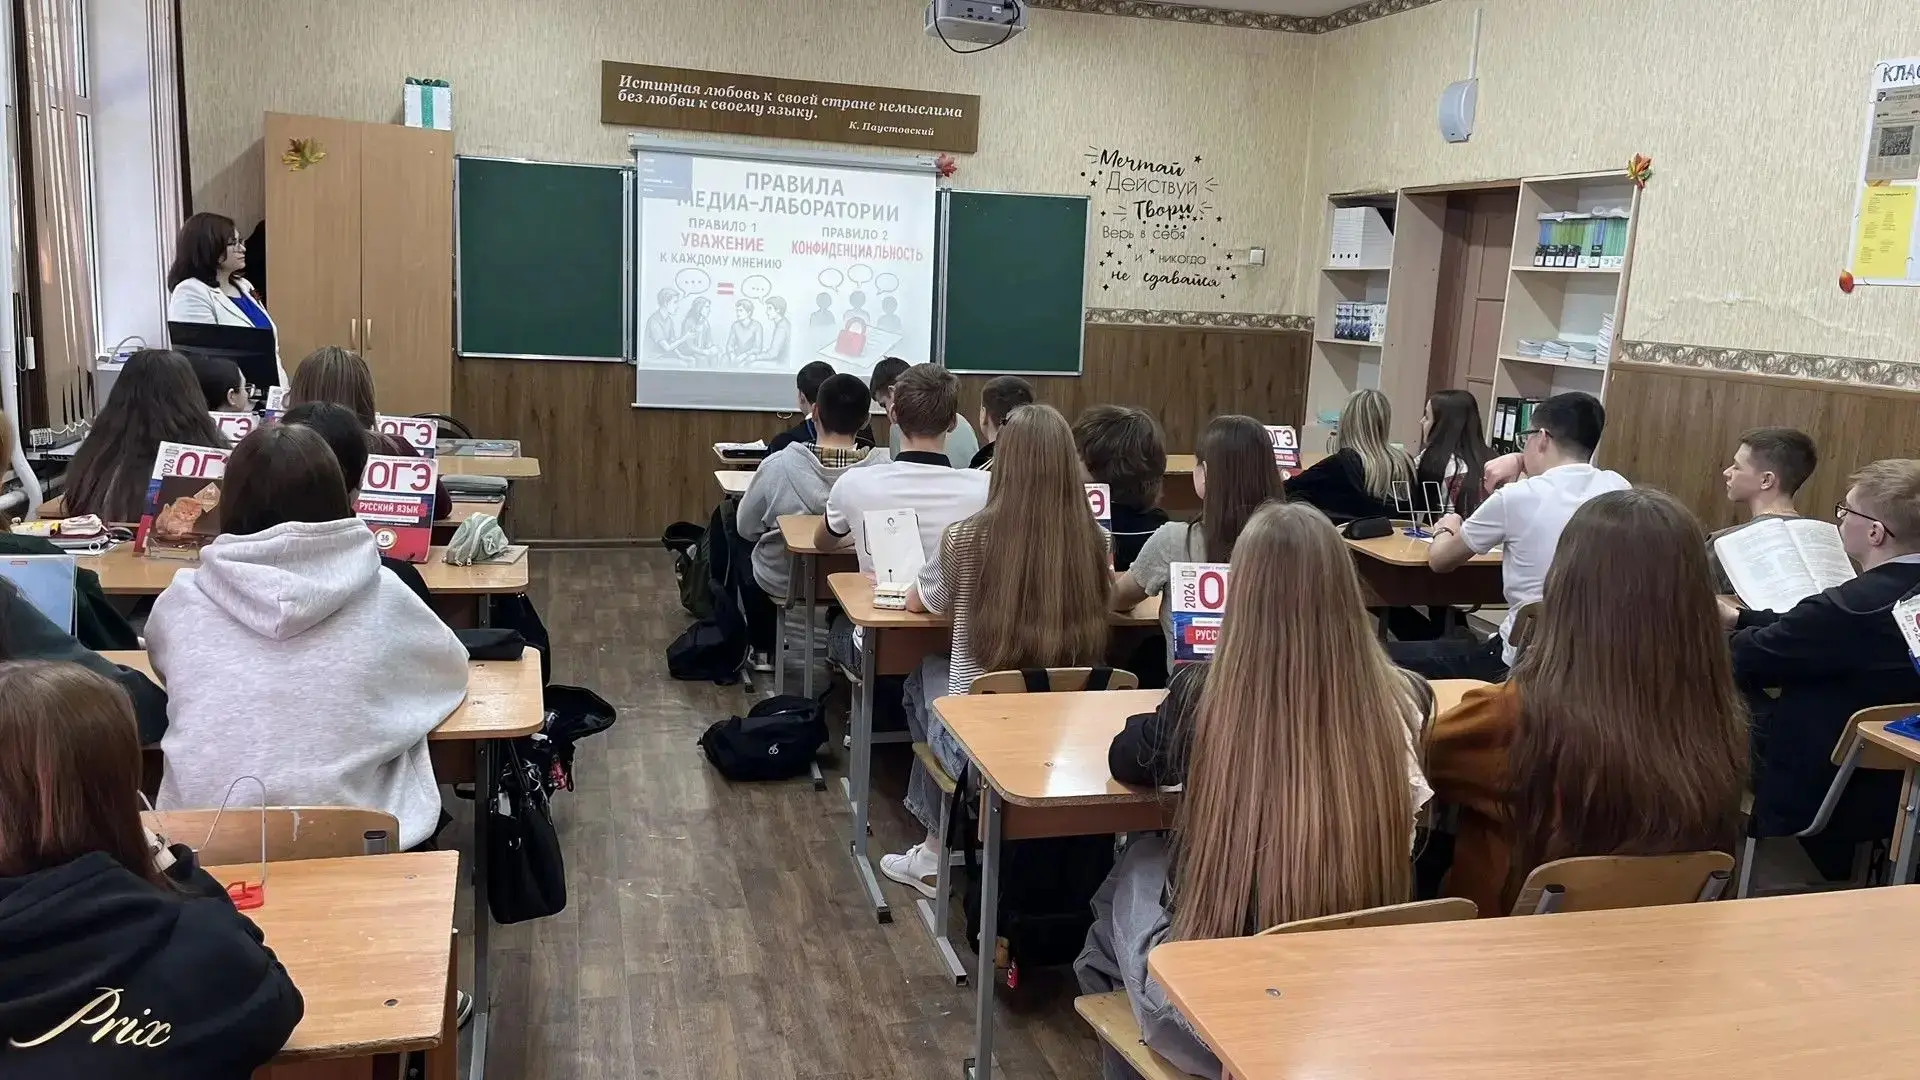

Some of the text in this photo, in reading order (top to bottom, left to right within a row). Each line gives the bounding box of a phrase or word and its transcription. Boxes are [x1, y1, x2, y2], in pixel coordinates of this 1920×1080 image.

[618, 74, 963, 118] Истинная любовь к своей стране немыслима
[618, 88, 818, 121] без любви к своему языку.
[848, 121, 935, 136] К. Паустовский
[1100, 149, 1186, 177] Мечтай
[745, 171, 845, 197] ПРАВИЛА
[1106, 171, 1198, 199] Действуй
[1132, 200, 1195, 221] Твори
[688, 217, 757, 233] ПРАВИЛО 1
[822, 226, 889, 240] ПРАВИЛО 2
[1102, 226, 1186, 240] Верь в себя
[681, 232, 764, 252] УВАЖЕНИЕ
[791, 239, 923, 261] КОНФИДЕНЦИАЛЬНОСТЬ
[659, 252, 782, 270] К КАЖДОМУ МНЕНИЮ
[1135, 254, 1143, 263] и
[1111, 270, 1221, 291] не сдавайся
[217, 416, 253, 439] ГЭ
[176, 451, 229, 477] ОГ
[367, 461, 431, 491] ОГЭ
[359, 501, 419, 514] РУССКИЙ ЯЗЫК
[1184, 583, 1196, 608] 2026
[1195, 629, 1220, 641] РУСС
[9, 986, 171, 1048] Prix
